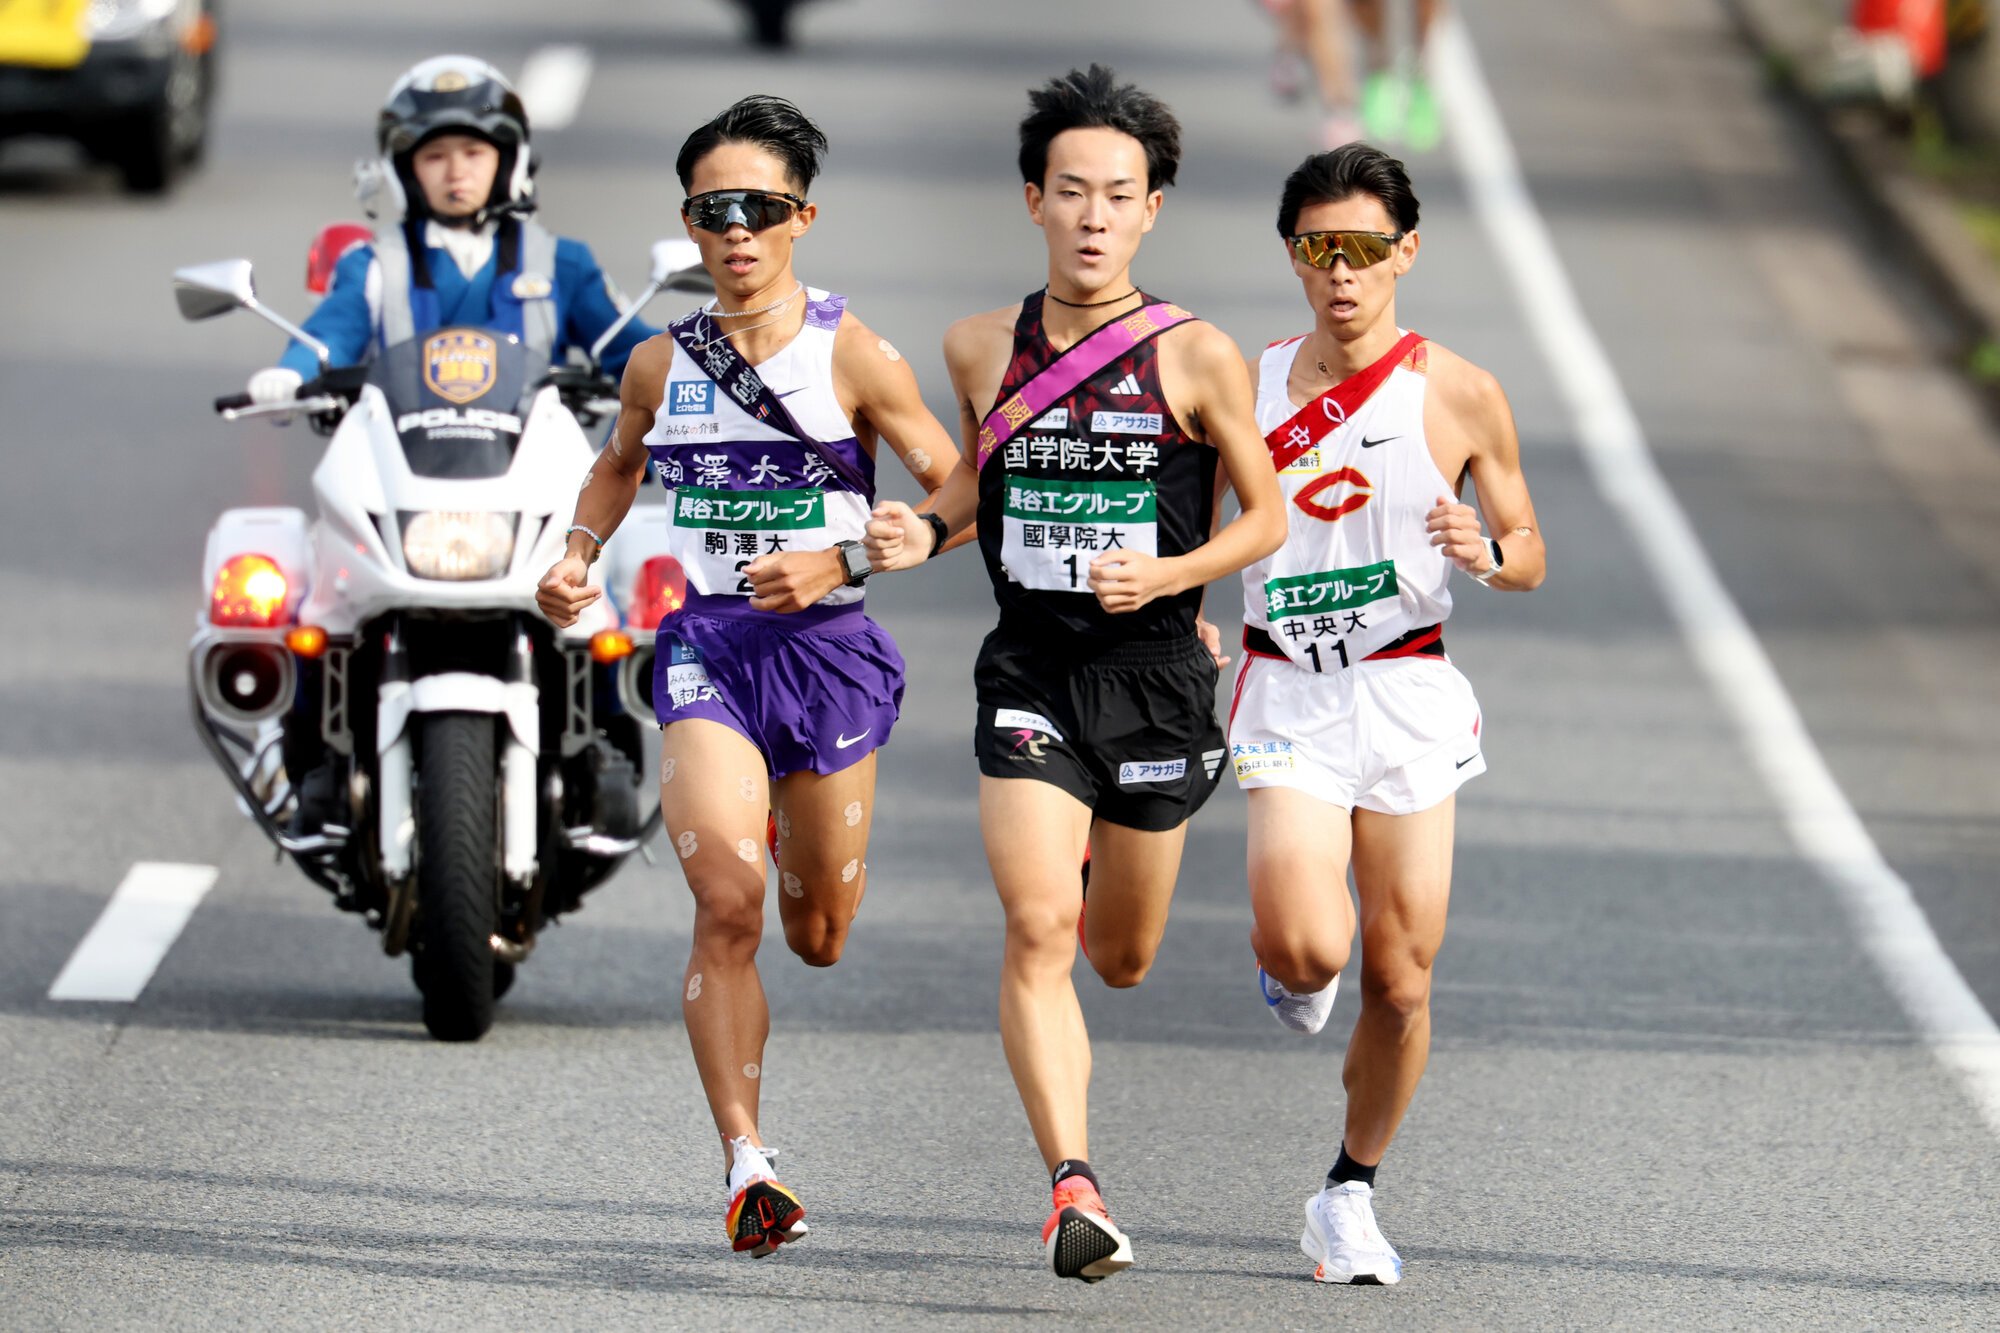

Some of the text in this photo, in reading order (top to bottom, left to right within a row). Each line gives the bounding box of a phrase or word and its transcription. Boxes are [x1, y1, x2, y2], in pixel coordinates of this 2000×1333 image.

[677, 383, 708, 403] HRS
[397, 408, 522, 434] POLICE
[666, 422, 720, 435] みんなの介護
[1112, 415, 1159, 430] アサガミ
[1003, 436, 1159, 474] 国学院大学
[704, 531, 789, 557] 駒澤大
[1023, 523, 1126, 551] 國學院大
[1063, 554, 1077, 588] 1
[1282, 610, 1368, 641] 中央大
[1304, 638, 1350, 673] 11
[670, 671, 708, 686] みんなの
[1138, 762, 1184, 776] アサガミ
